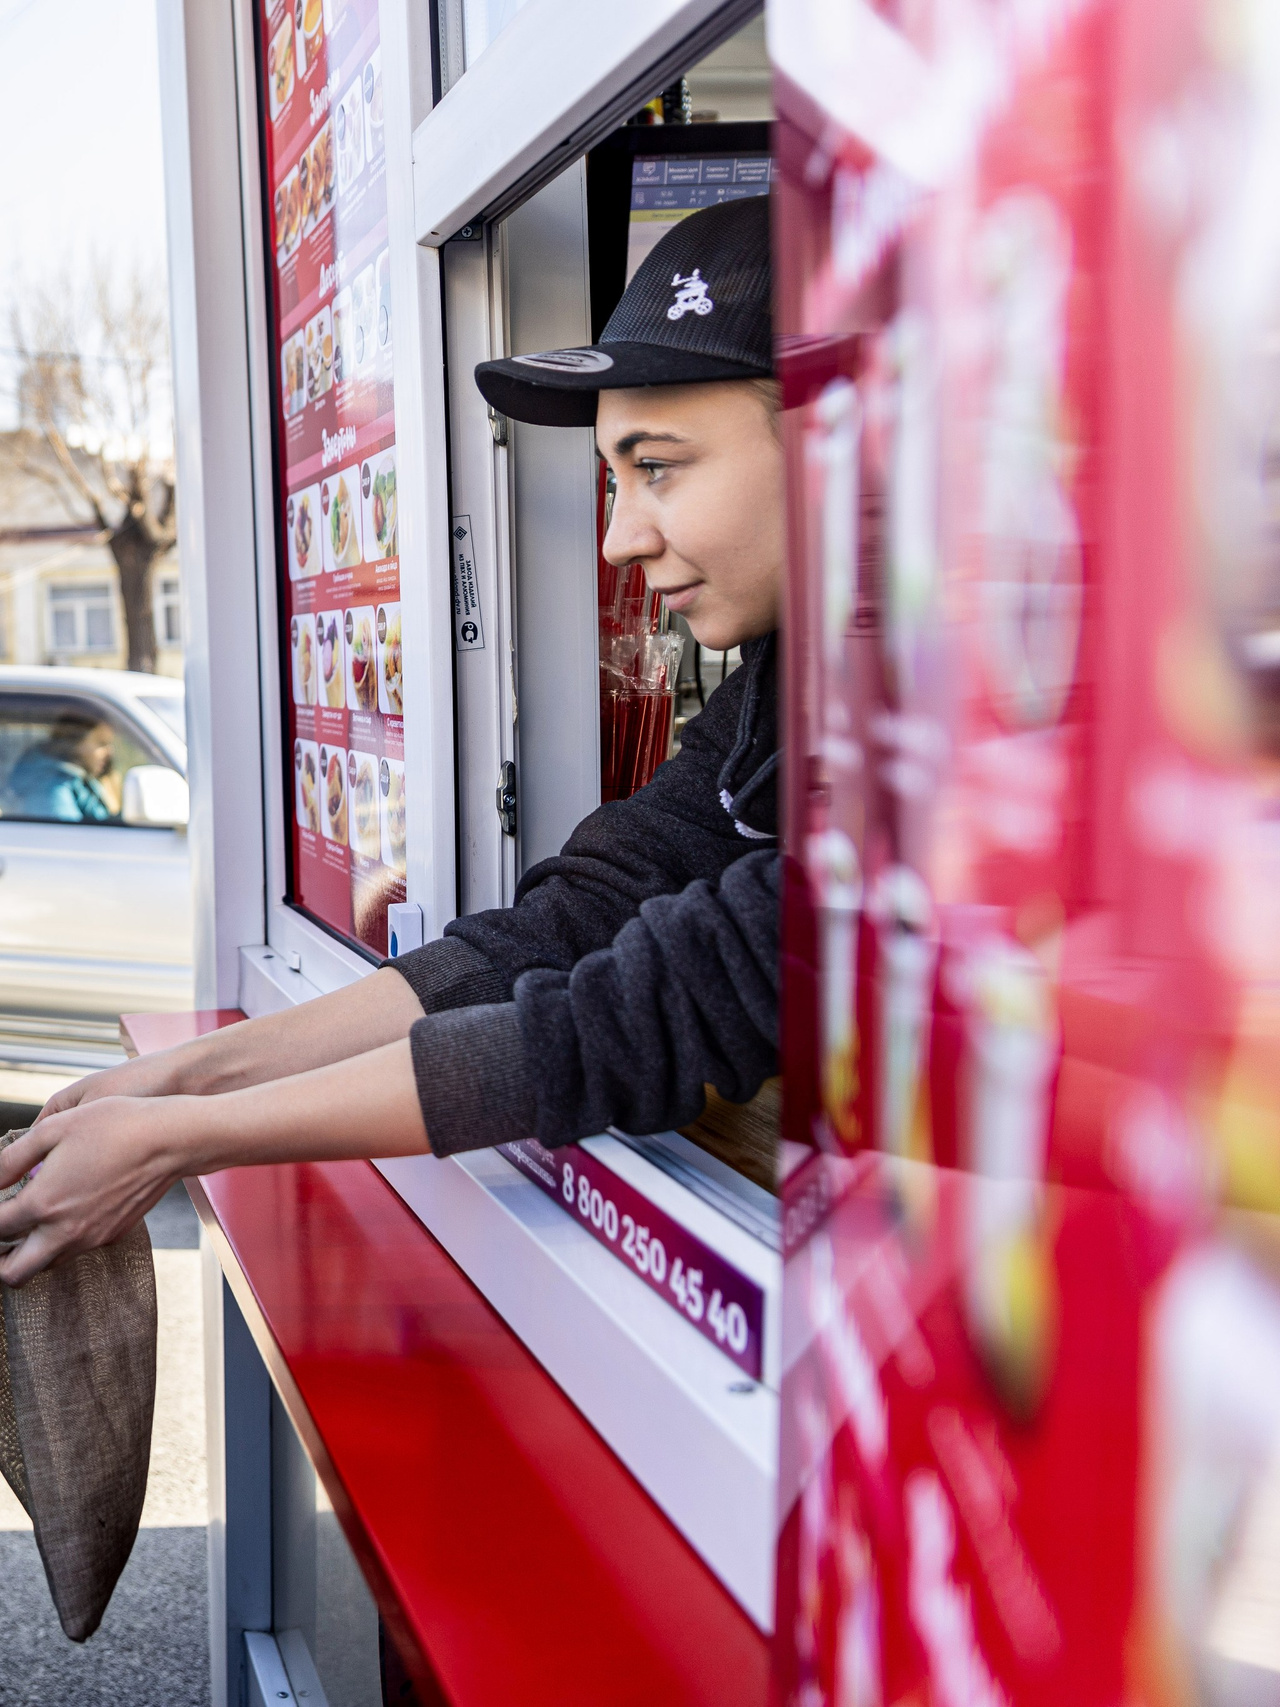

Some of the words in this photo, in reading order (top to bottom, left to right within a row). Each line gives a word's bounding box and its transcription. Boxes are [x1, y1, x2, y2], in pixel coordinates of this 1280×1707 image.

[458, 553, 464, 561] ИЗ
[462, 580, 470, 615] АЛЮМИНИЯ
[468, 581, 476, 607] ИЗДЕЛИЙ
[562, 1162, 574, 1204] 8
[578, 1174, 618, 1242] 800
[621, 1214, 667, 1284] 250
[670, 1257, 704, 1322] 45
[707, 1289, 748, 1355] 40
